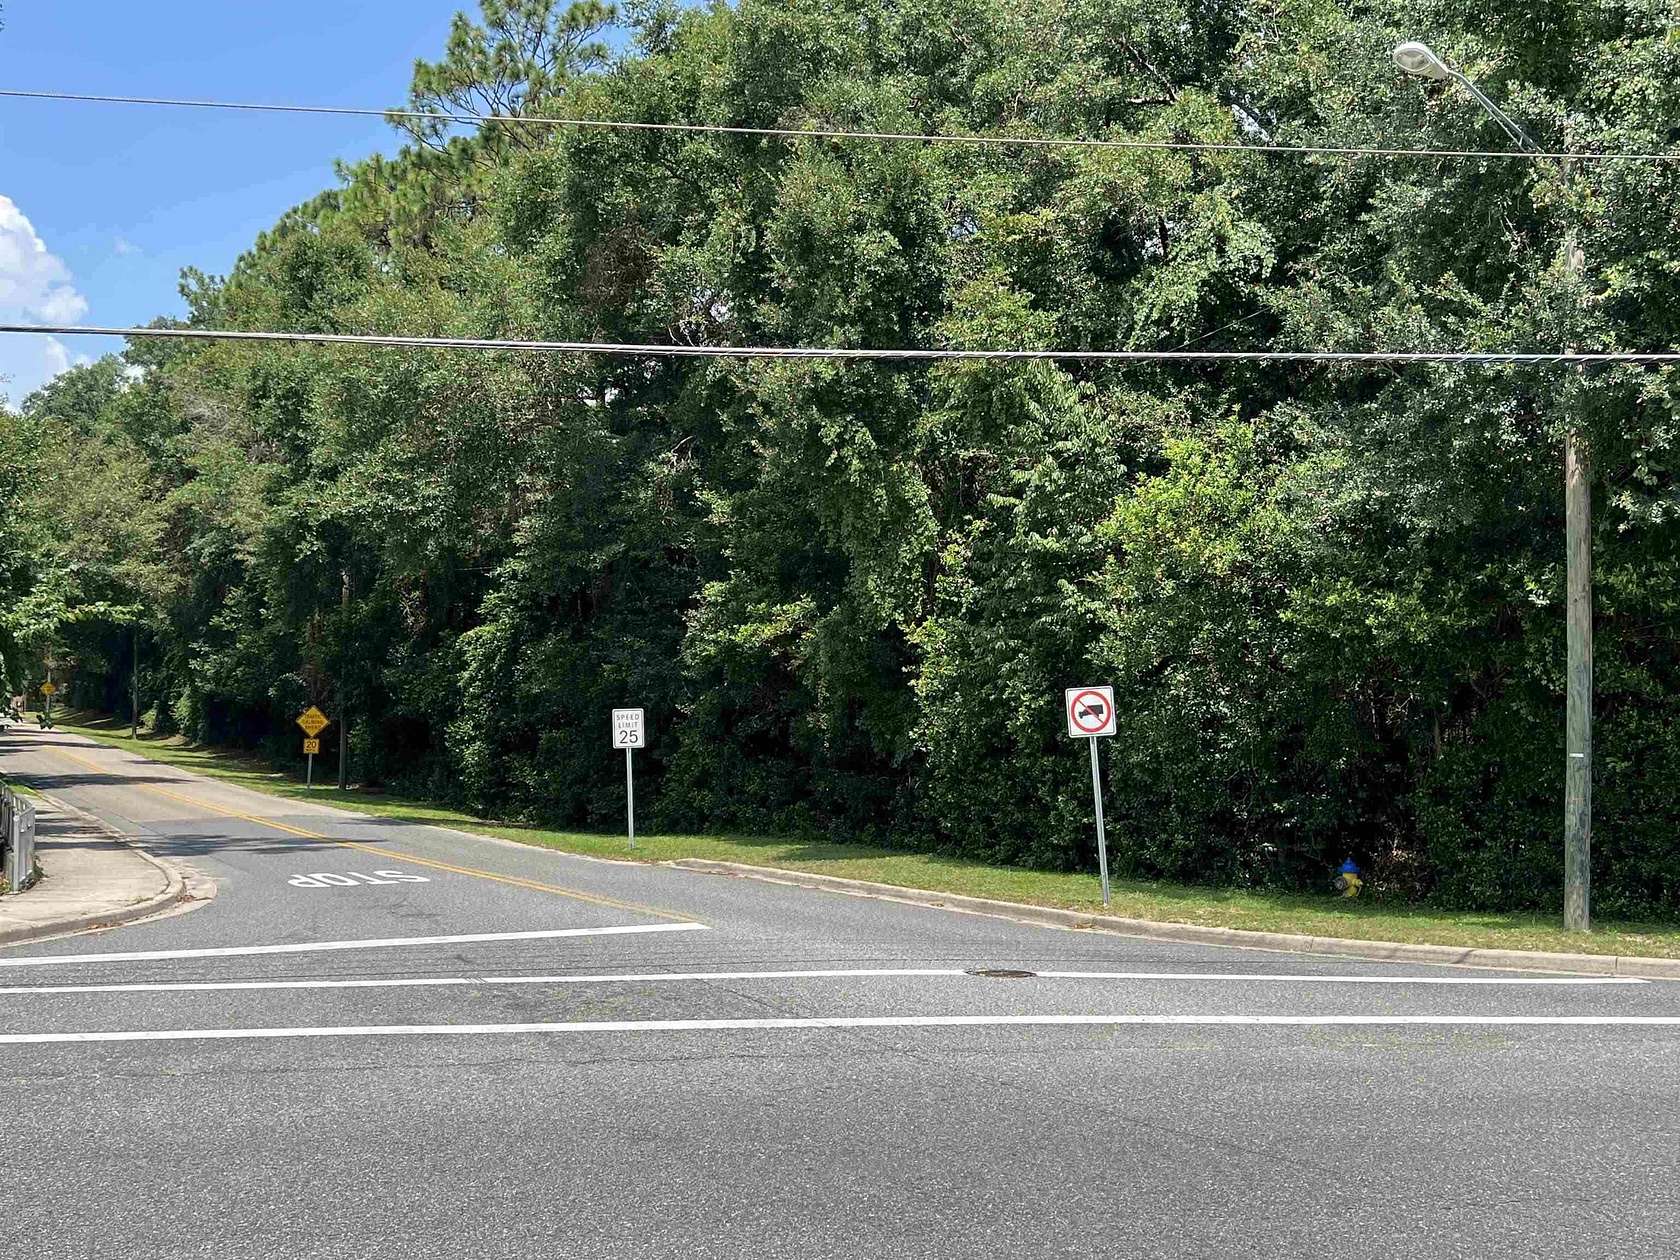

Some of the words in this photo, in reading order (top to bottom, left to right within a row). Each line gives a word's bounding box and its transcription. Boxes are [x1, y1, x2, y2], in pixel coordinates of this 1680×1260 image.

[618, 721, 638, 729] LIMIT
[619, 730, 638, 744] 25
[306, 741, 317, 749] 20
[287, 870, 431, 888] STOP
